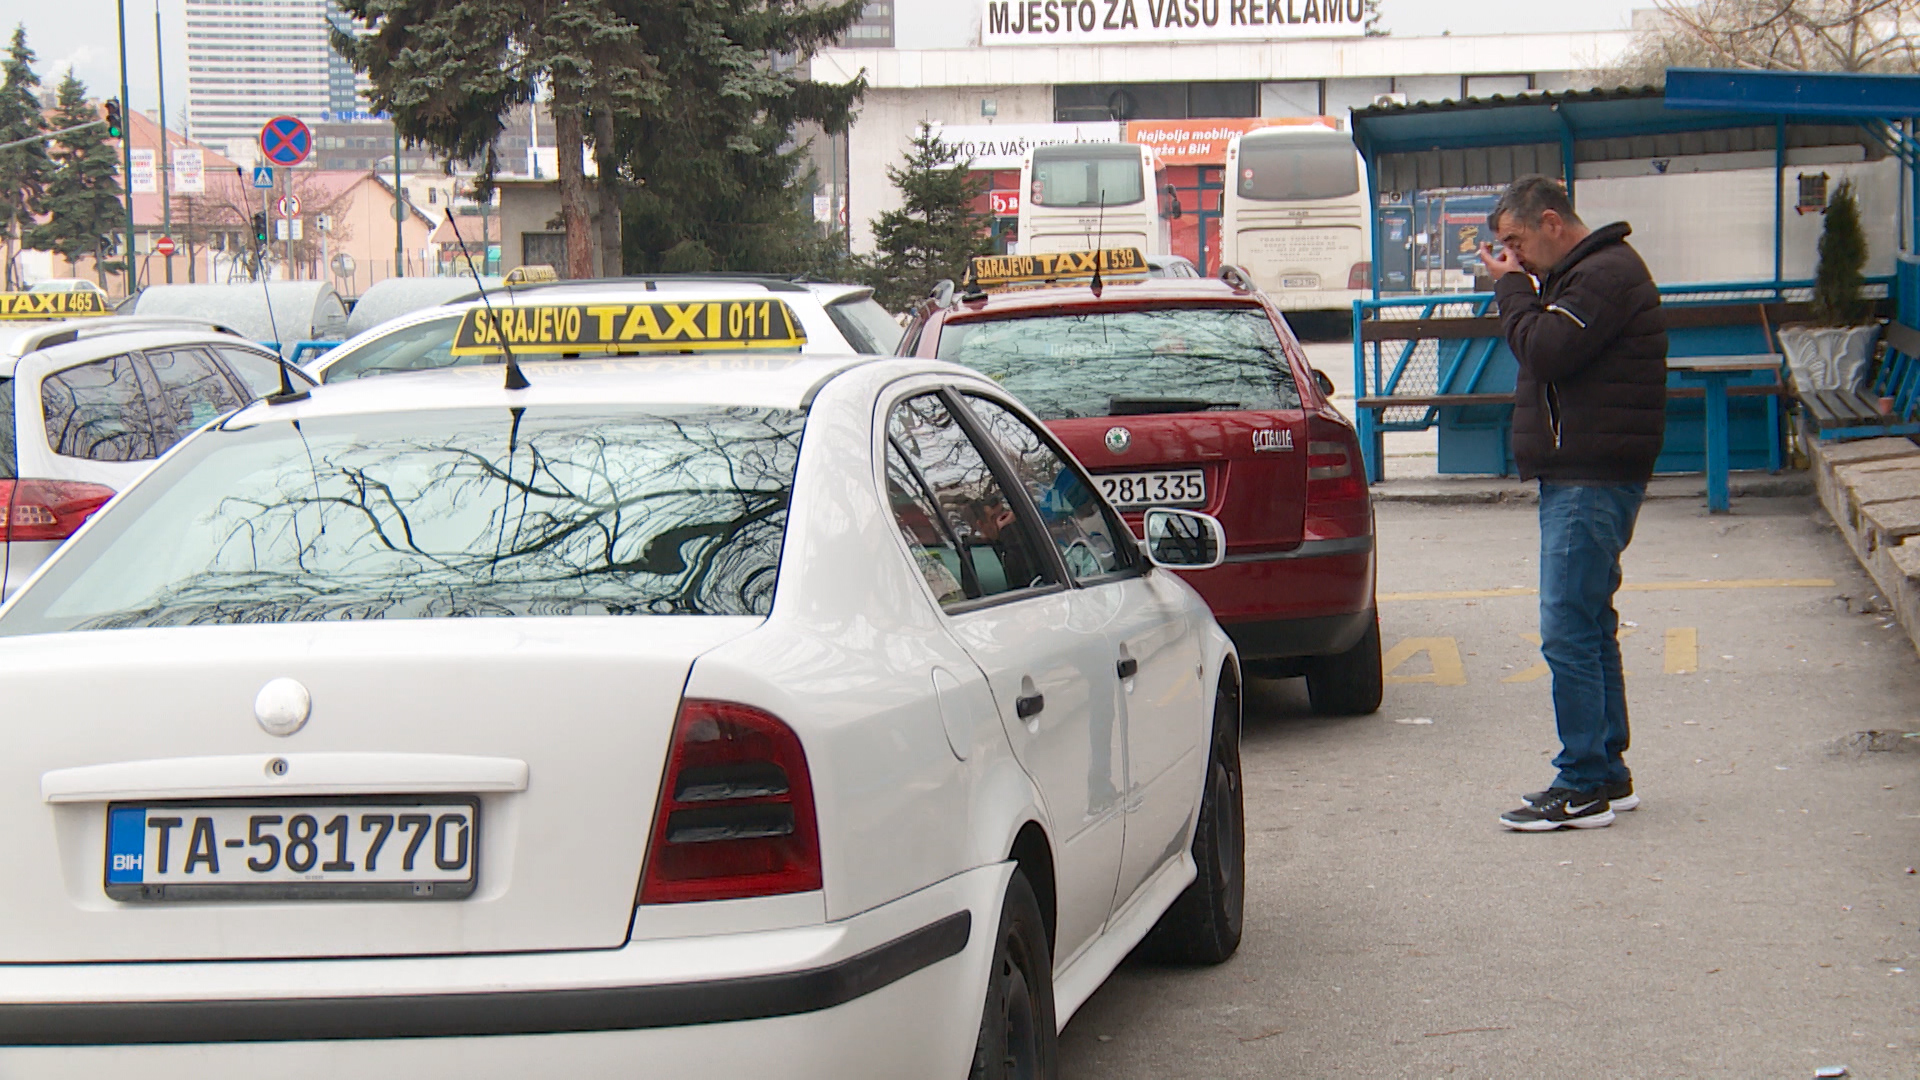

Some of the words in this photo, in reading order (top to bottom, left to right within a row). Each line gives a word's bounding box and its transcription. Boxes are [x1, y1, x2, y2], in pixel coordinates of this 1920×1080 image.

[990, 0, 1096, 34] MJESTO
[1103, 0, 1138, 30] ZA
[1231, 0, 1364, 25] REKLAMU
[938, 142, 975, 157] JESTO
[979, 142, 996, 156] ZA
[1137, 129, 1190, 144] Najbolja
[976, 256, 1034, 278] SARAJEVO
[1036, 250, 1107, 273] TAXI
[1111, 248, 1135, 268] 539
[0, 293, 66, 314] TAXI
[69, 292, 93, 312] 465
[474, 306, 581, 344] SARAJEVO
[587, 303, 722, 341] TAXI
[728, 301, 771, 339] 011
[1102, 474, 1203, 504] 281335
[147, 813, 469, 875] TA-581770
[113, 854, 142, 871] BIH
